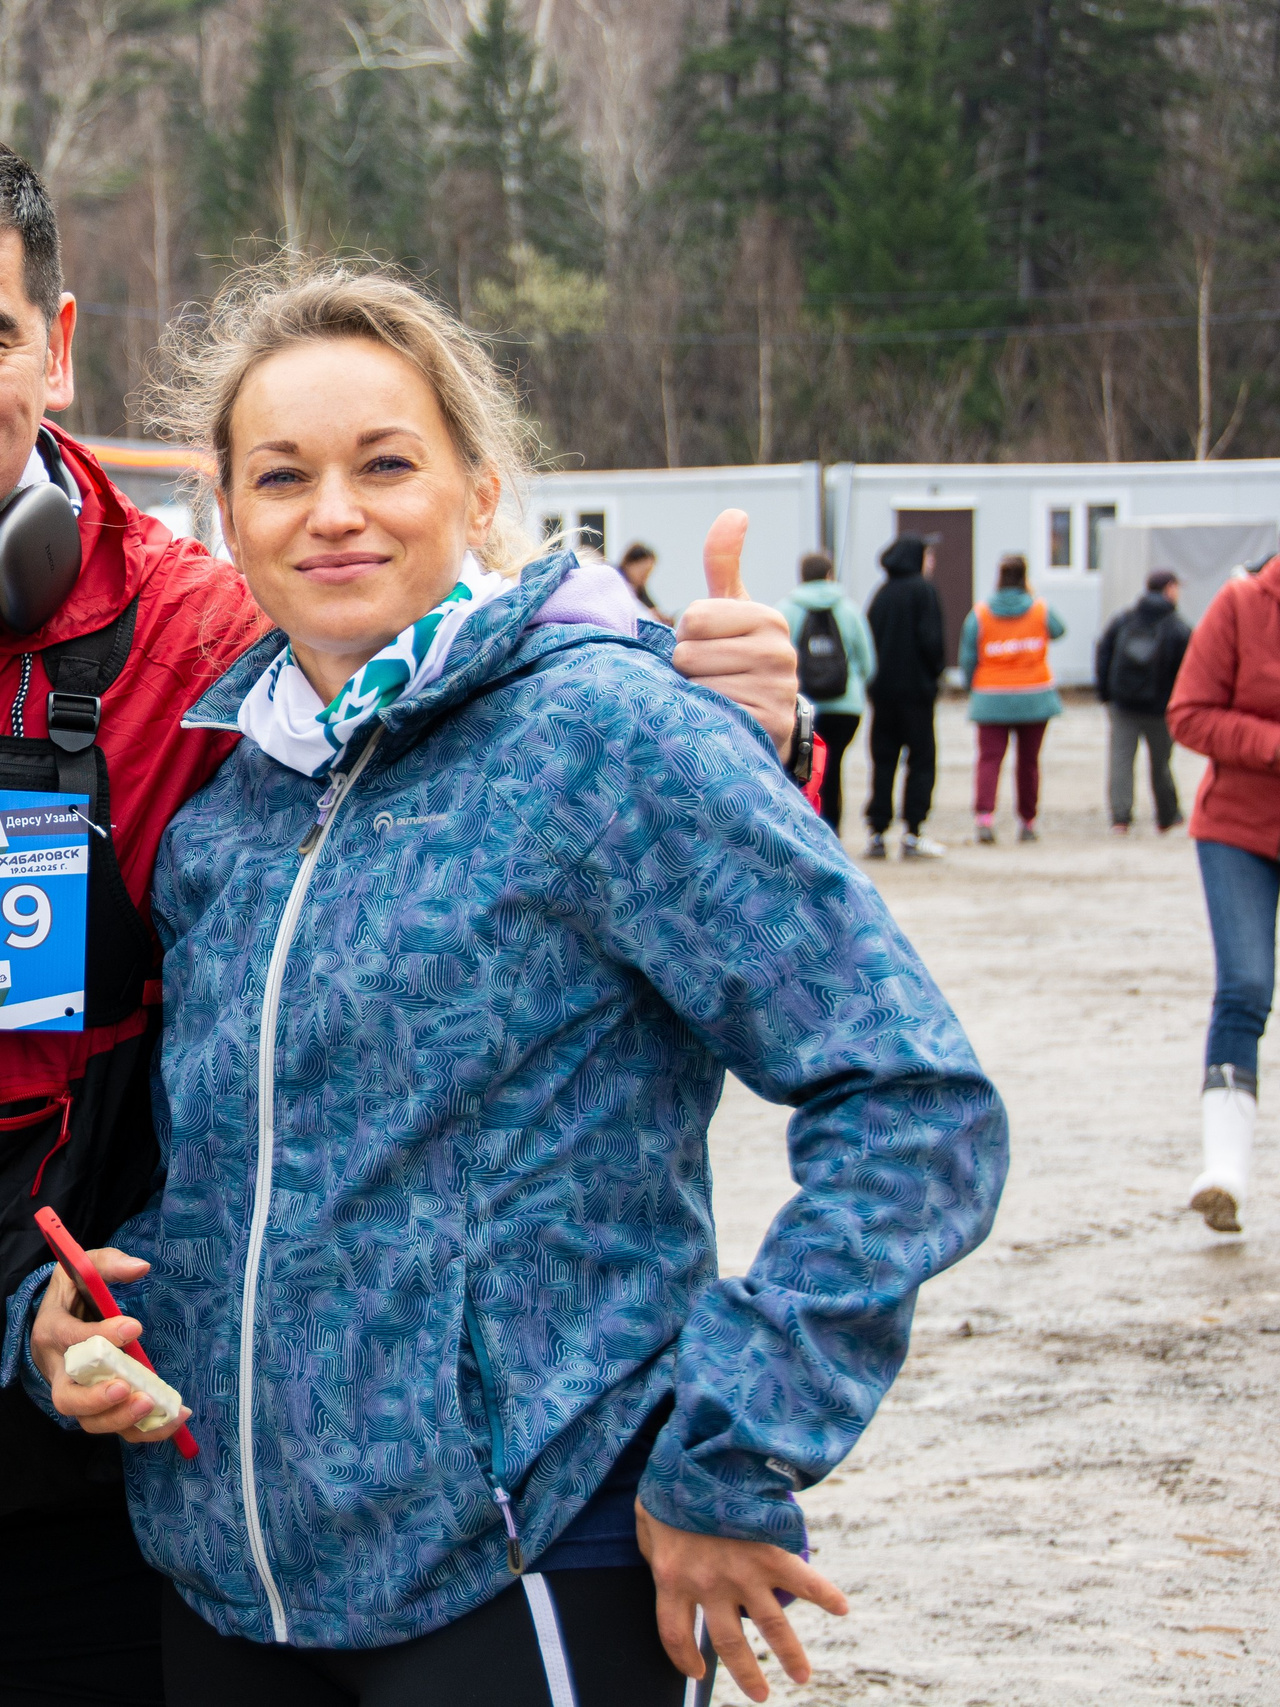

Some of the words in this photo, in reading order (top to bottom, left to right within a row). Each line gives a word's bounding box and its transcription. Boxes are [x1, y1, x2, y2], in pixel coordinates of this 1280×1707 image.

[6, 816, 41, 829] Дерсу
[44, 813, 79, 824] Узала
[0, 848, 80, 867] ХАБАРОВСК
[10, 864, 58, 875] 19.04.2025
